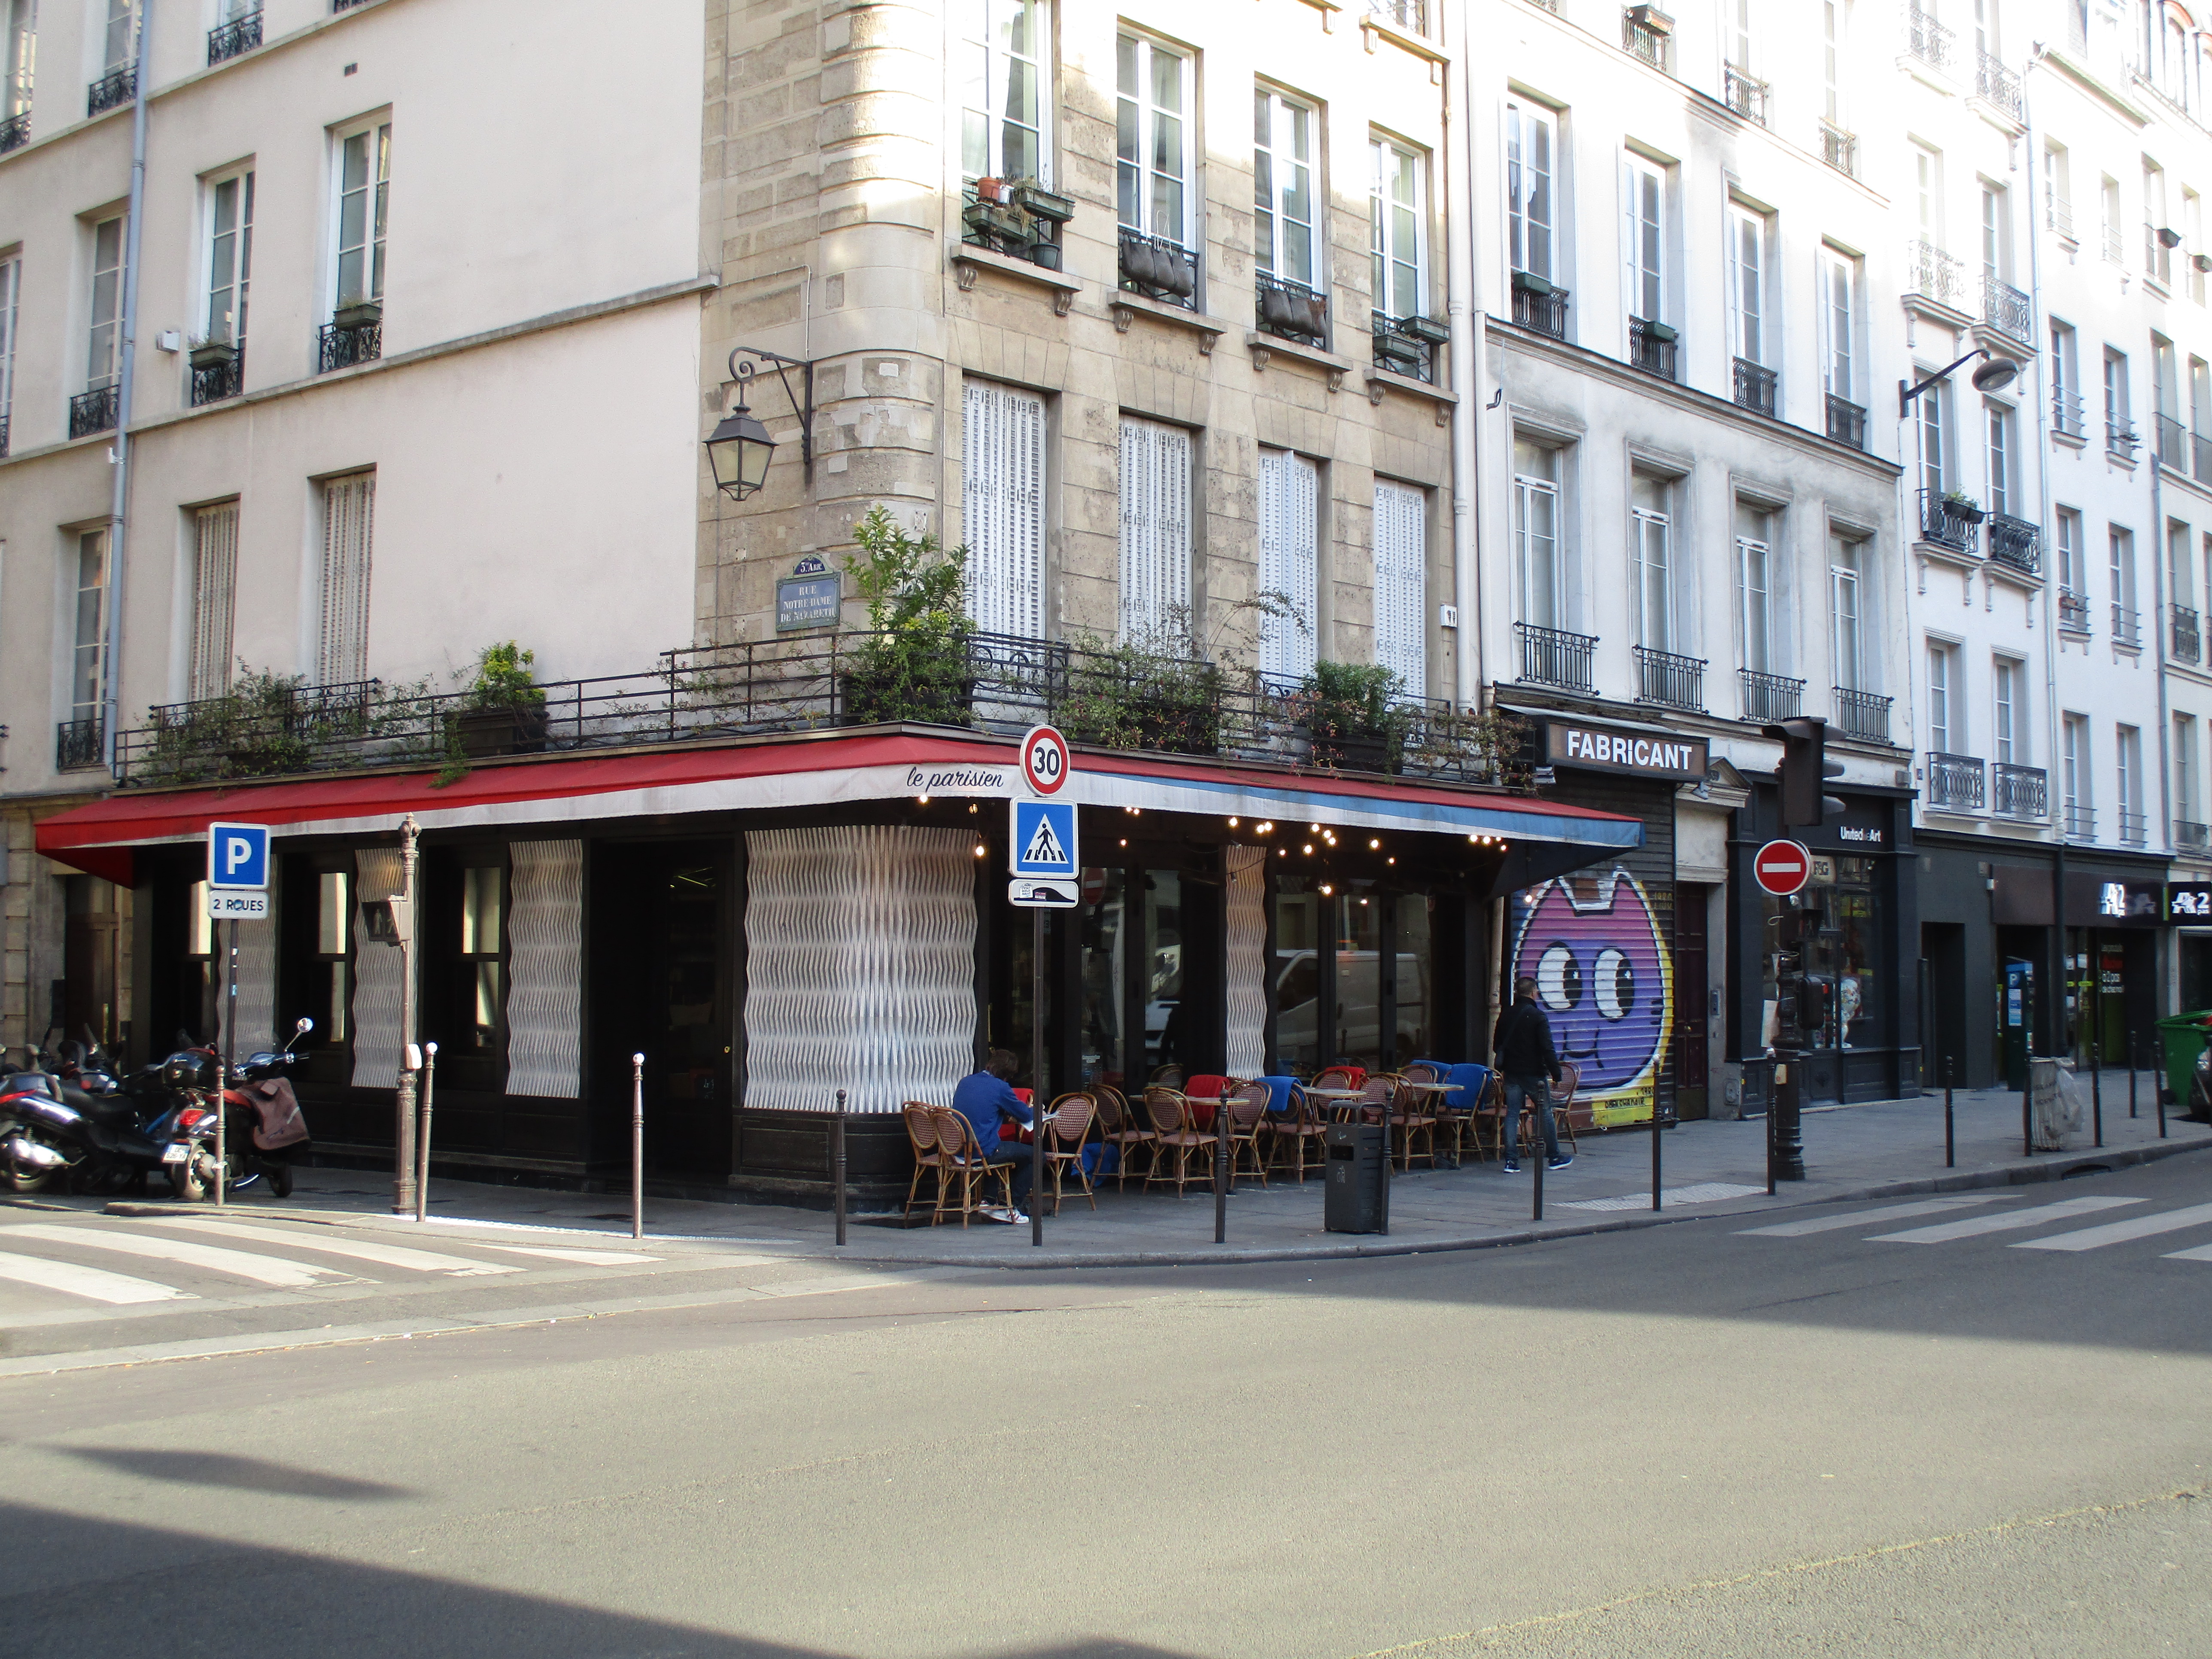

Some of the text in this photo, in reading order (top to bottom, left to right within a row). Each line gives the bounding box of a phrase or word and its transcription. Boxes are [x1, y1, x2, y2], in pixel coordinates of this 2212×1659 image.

[799, 585, 816, 596] RUE
[784, 596, 832, 610] NOTRE-DAME
[781, 608, 836, 622] DE NAZARETH
[1567, 731, 1692, 770] FABRICANT
[1034, 747, 1060, 776] 30
[906, 766, 1004, 793] le parisien
[1840, 826, 1863, 841] United
[1869, 829, 1881, 842] Art
[227, 837, 252, 875] P
[213, 899, 264, 911] 2 ROUES
